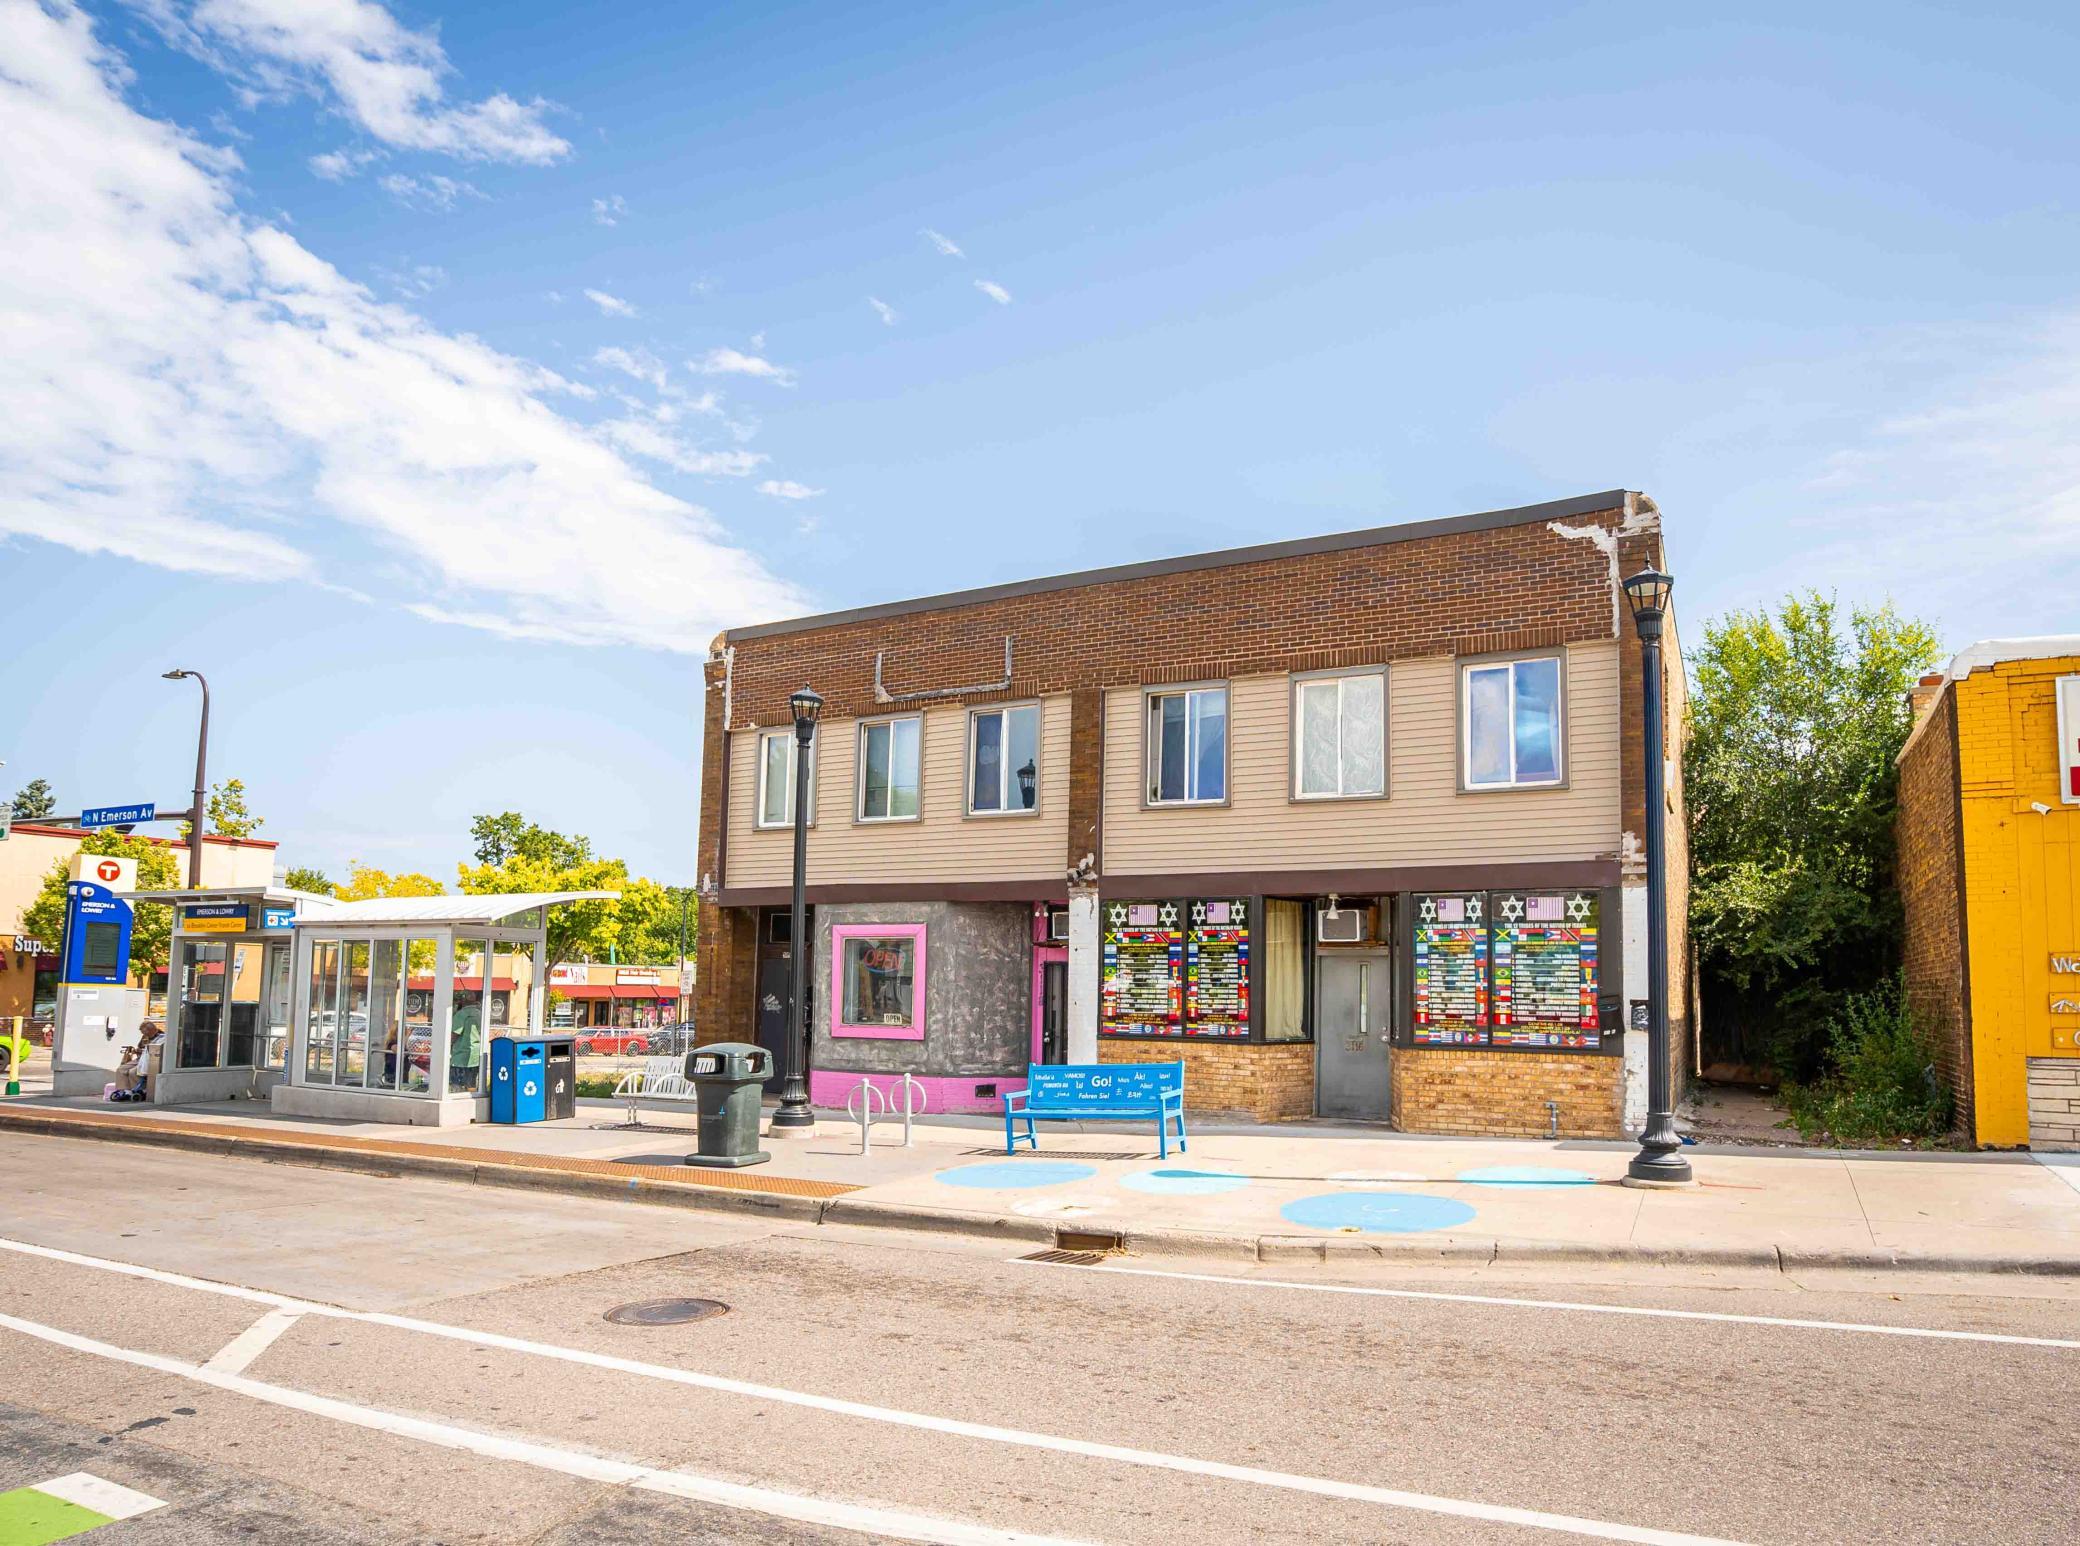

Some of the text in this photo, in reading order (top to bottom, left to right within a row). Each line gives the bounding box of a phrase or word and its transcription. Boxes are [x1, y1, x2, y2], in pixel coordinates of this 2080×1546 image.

[92, 807, 152, 823] N Emerson Av
[196, 908, 215, 916] EMERSON
[864, 948, 905, 971] OPEN
[885, 1015, 901, 1023] OPEN
[1091, 1075, 1112, 1087] Go!
[1078, 1092, 1098, 1100] Fahren
